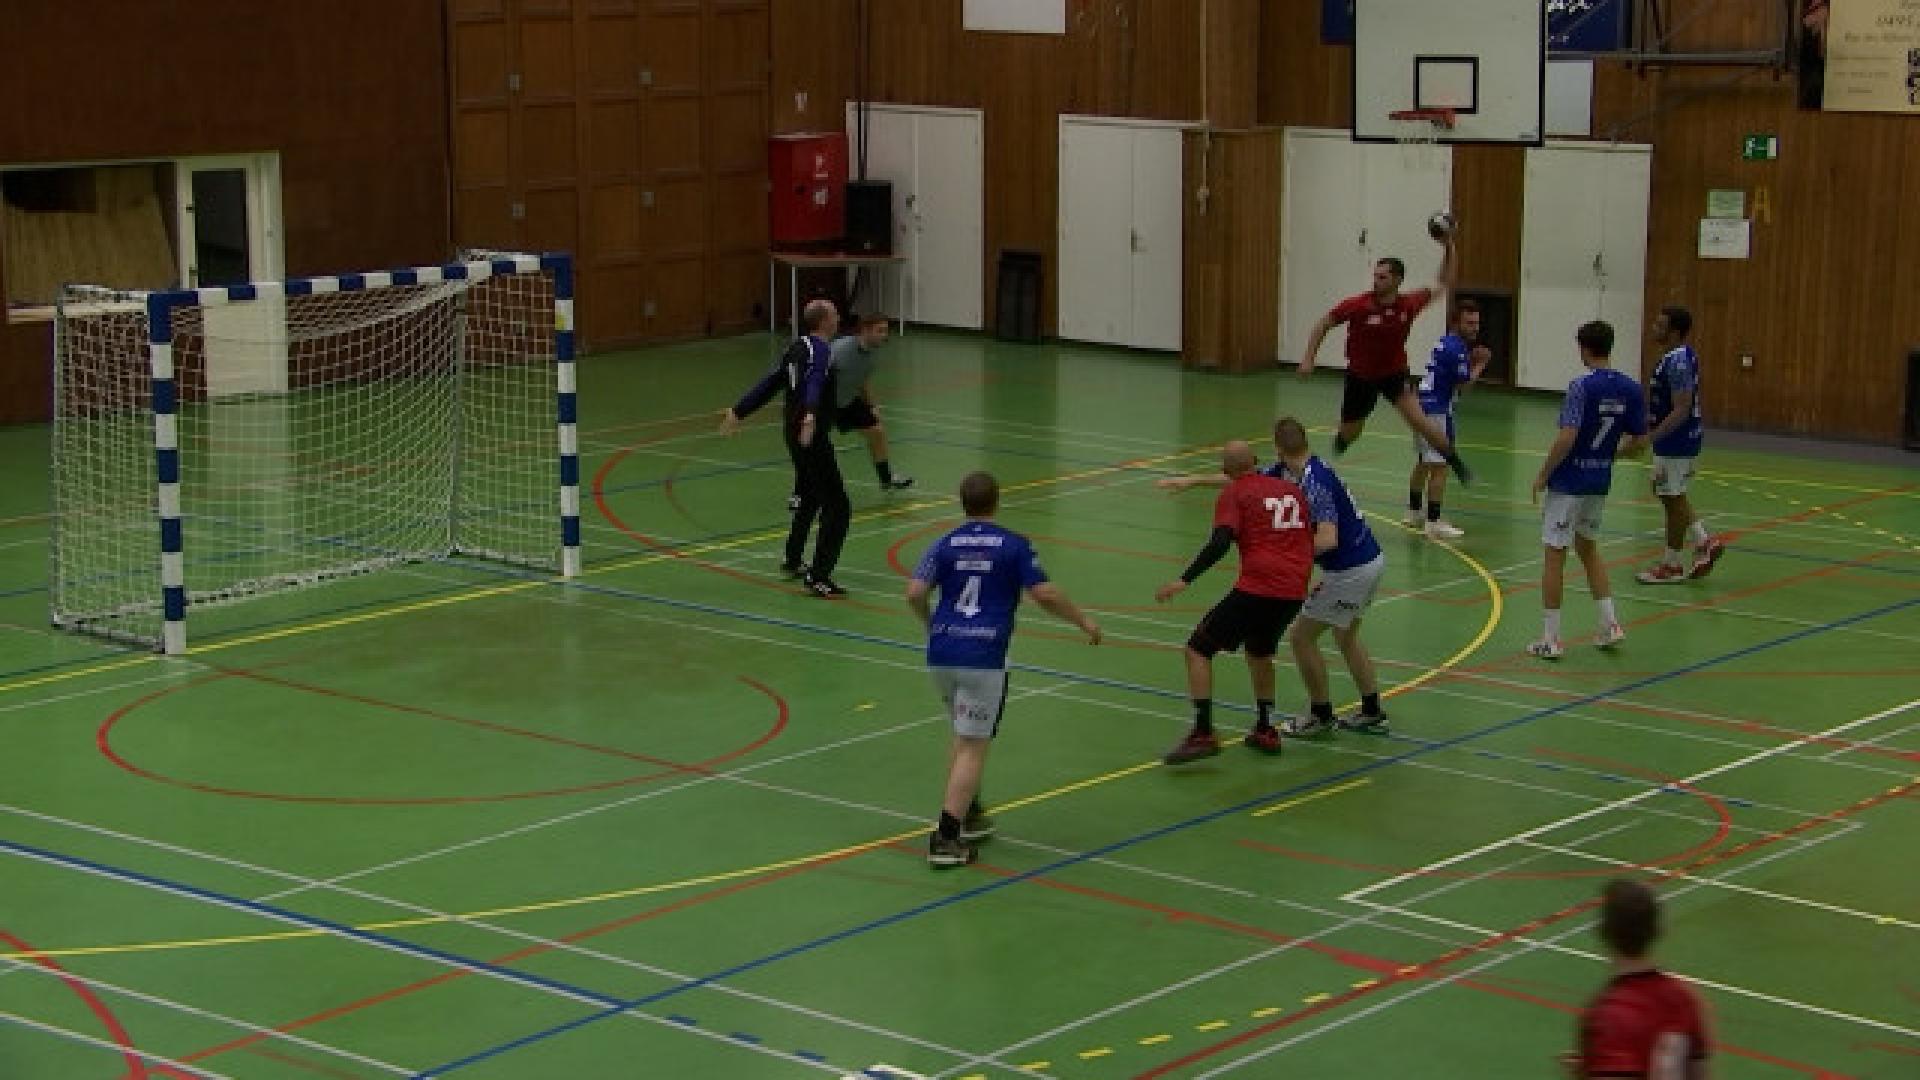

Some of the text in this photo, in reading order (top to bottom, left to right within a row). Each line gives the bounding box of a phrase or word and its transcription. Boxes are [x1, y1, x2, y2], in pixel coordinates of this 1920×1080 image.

[1592, 416, 1615, 449] 7
[1263, 494, 1305, 530] 22
[954, 575, 982, 618] 4
